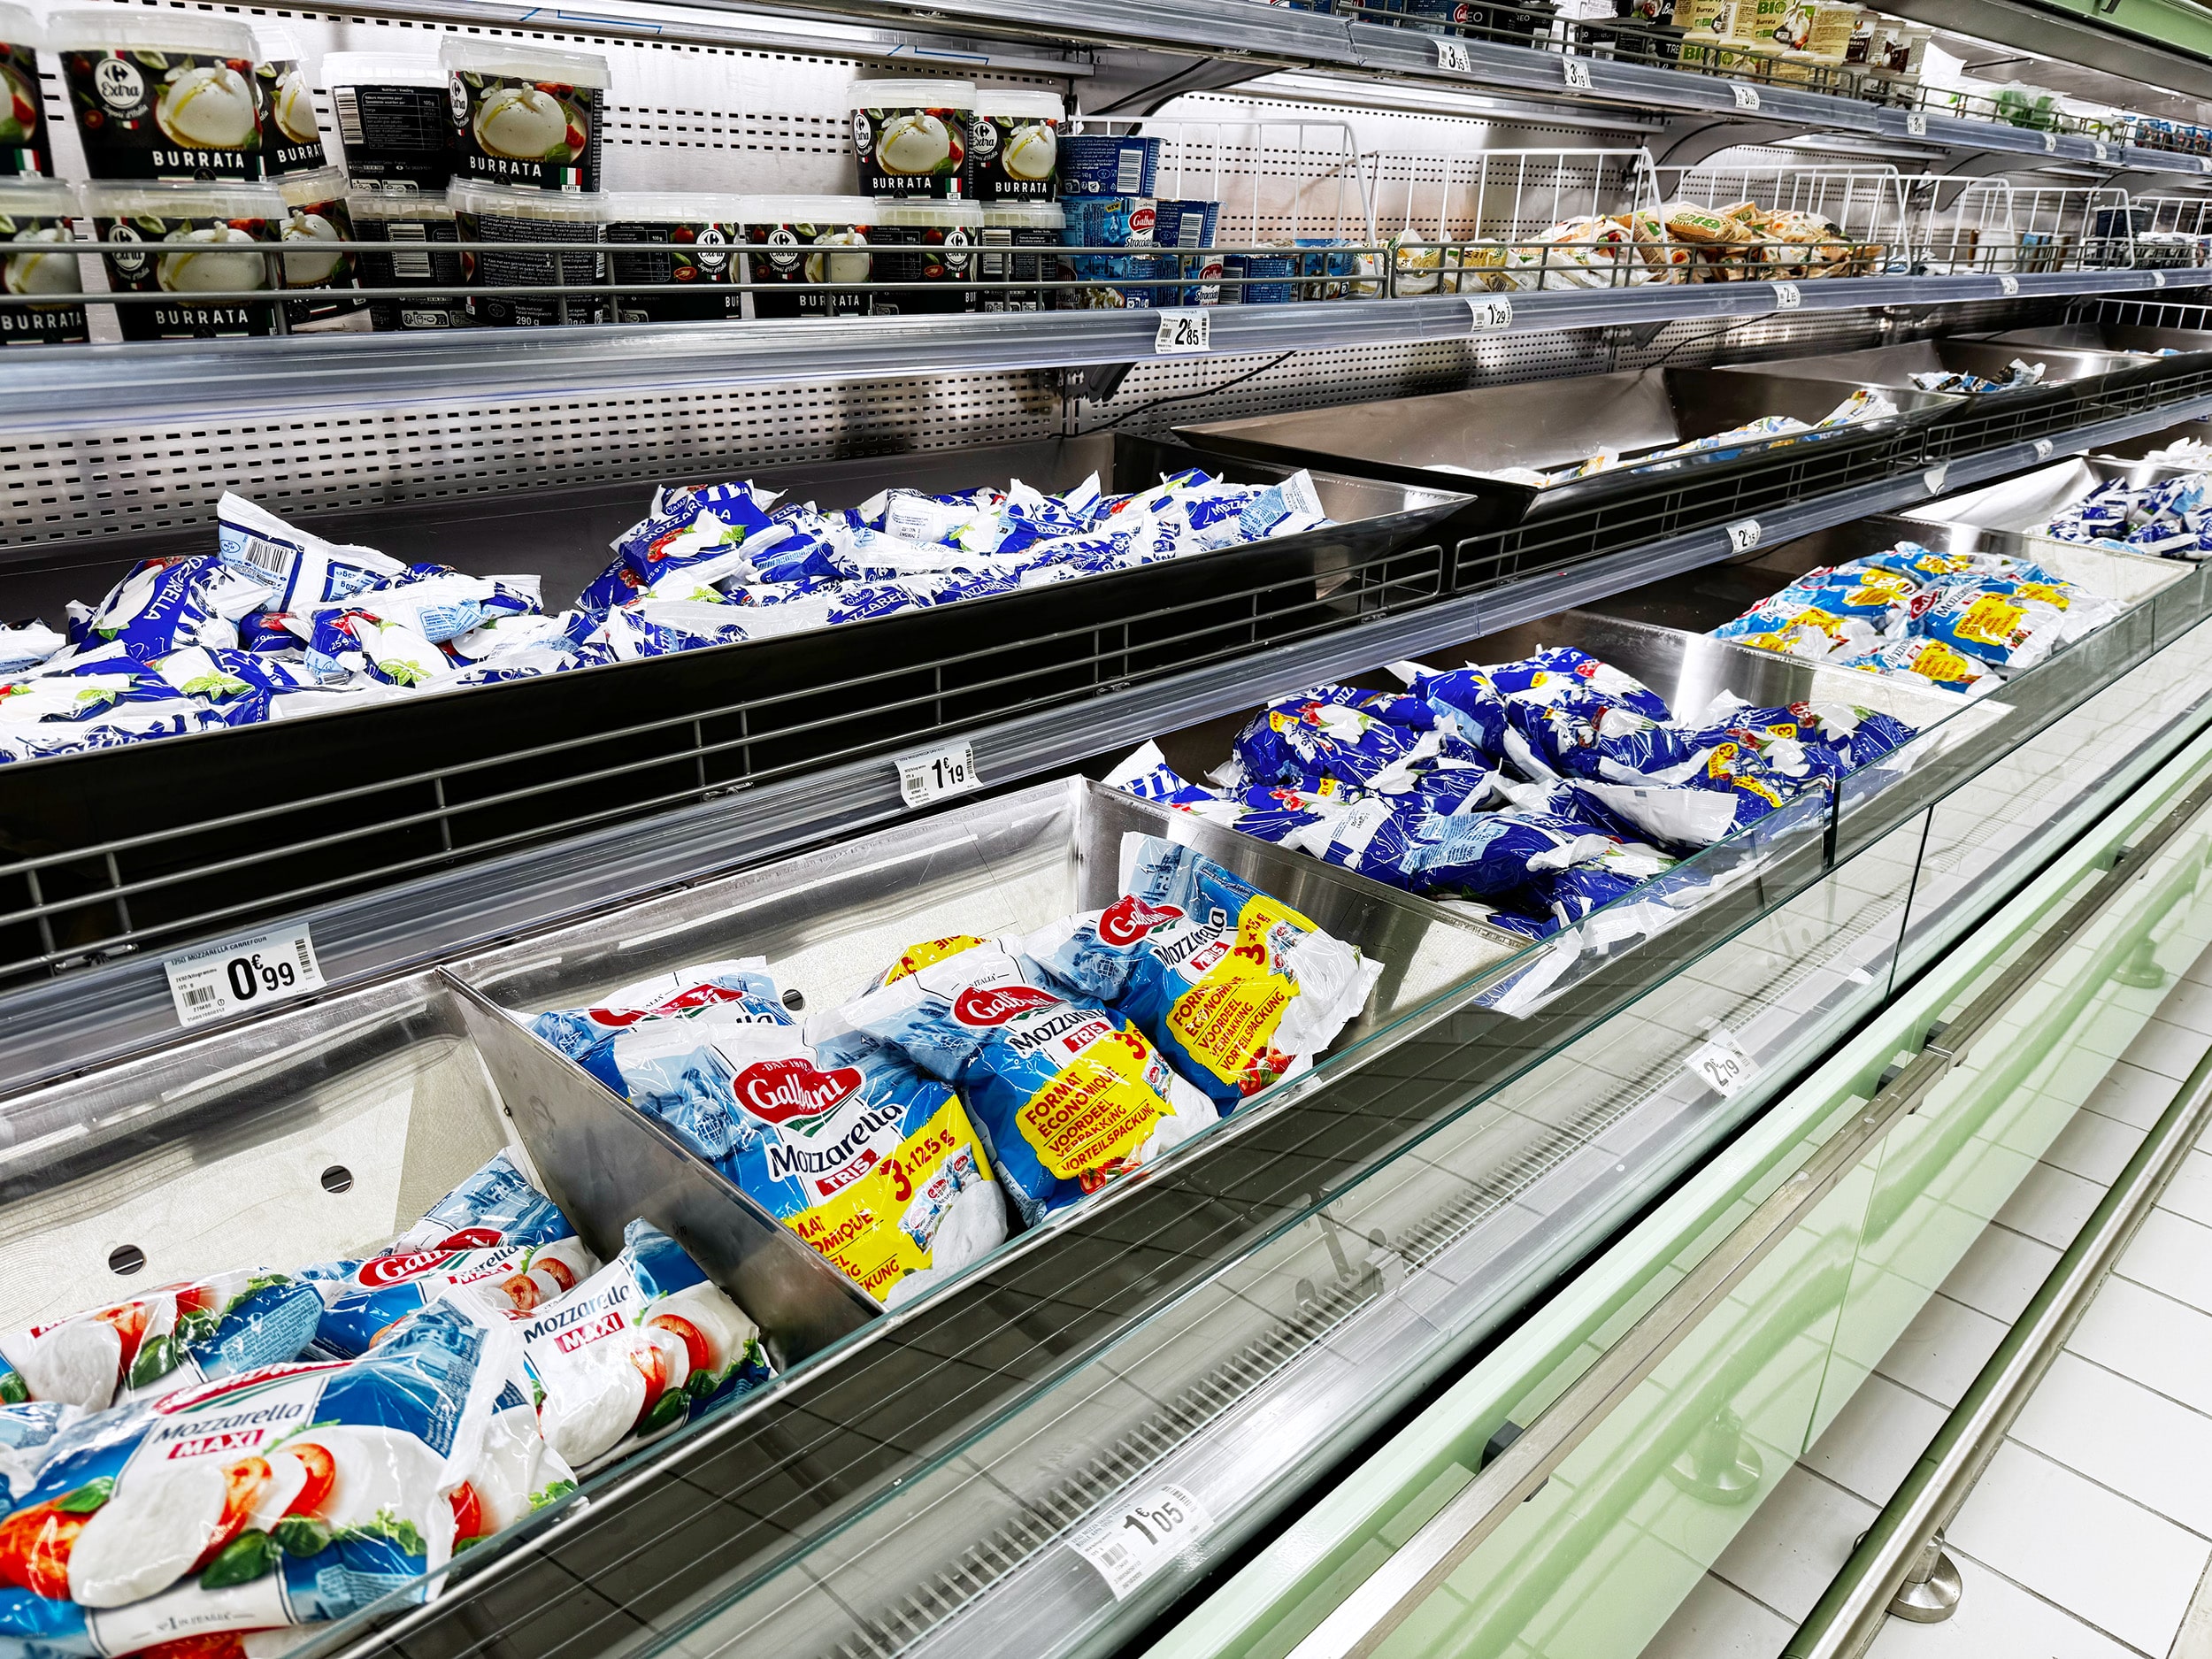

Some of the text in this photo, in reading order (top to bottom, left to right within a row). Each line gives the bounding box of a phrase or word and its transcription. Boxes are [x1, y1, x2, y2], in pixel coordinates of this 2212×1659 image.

[101, 83, 140, 99] Extra
[152, 150, 245, 168] BURRATA
[470, 156, 541, 178] BURRATA
[872, 177, 932, 189] BURRATA
[995, 181, 1047, 193] BURRATA
[799, 295, 860, 306] BURRATA
[1, 311, 82, 331] BURRATA
[156, 309, 249, 325] BURRATA
[516, 316, 532, 325] 290
[1175, 318, 1200, 345] 2€85
[932, 757, 964, 788] 1€19
[188, 946, 228, 963] MOZZARELLA
[229, 936, 267, 950] CARREFOUR
[227, 953, 296, 1001] 0€99
[1071, 1023, 1104, 1049] TRIS
[1198, 998, 1243, 1049] VOORDEEL
[1221, 991, 1286, 1071] VORTEILSPACKUNG
[1703, 1058, 1740, 1087] 2€79
[747, 1069, 848, 1110] Galbani
[1025, 1071, 1085, 1127] FORMAT
[772, 1104, 902, 1177] Mozzarella
[1048, 1099, 1115, 1155] VOORDEEL
[1062, 1102, 1156, 1171] VORTEILSPACKUNG
[826, 1156, 872, 1189] TRIS
[879, 1157, 912, 1202] 3
[910, 1137, 941, 1168] 125
[524, 1284, 632, 1343] Mozzarella
[560, 1315, 622, 1352] MAXI
[154, 1402, 305, 1444] Mozzarella
[175, 1429, 262, 1456] MAXI
[1123, 1502, 1185, 1546] 1€05
